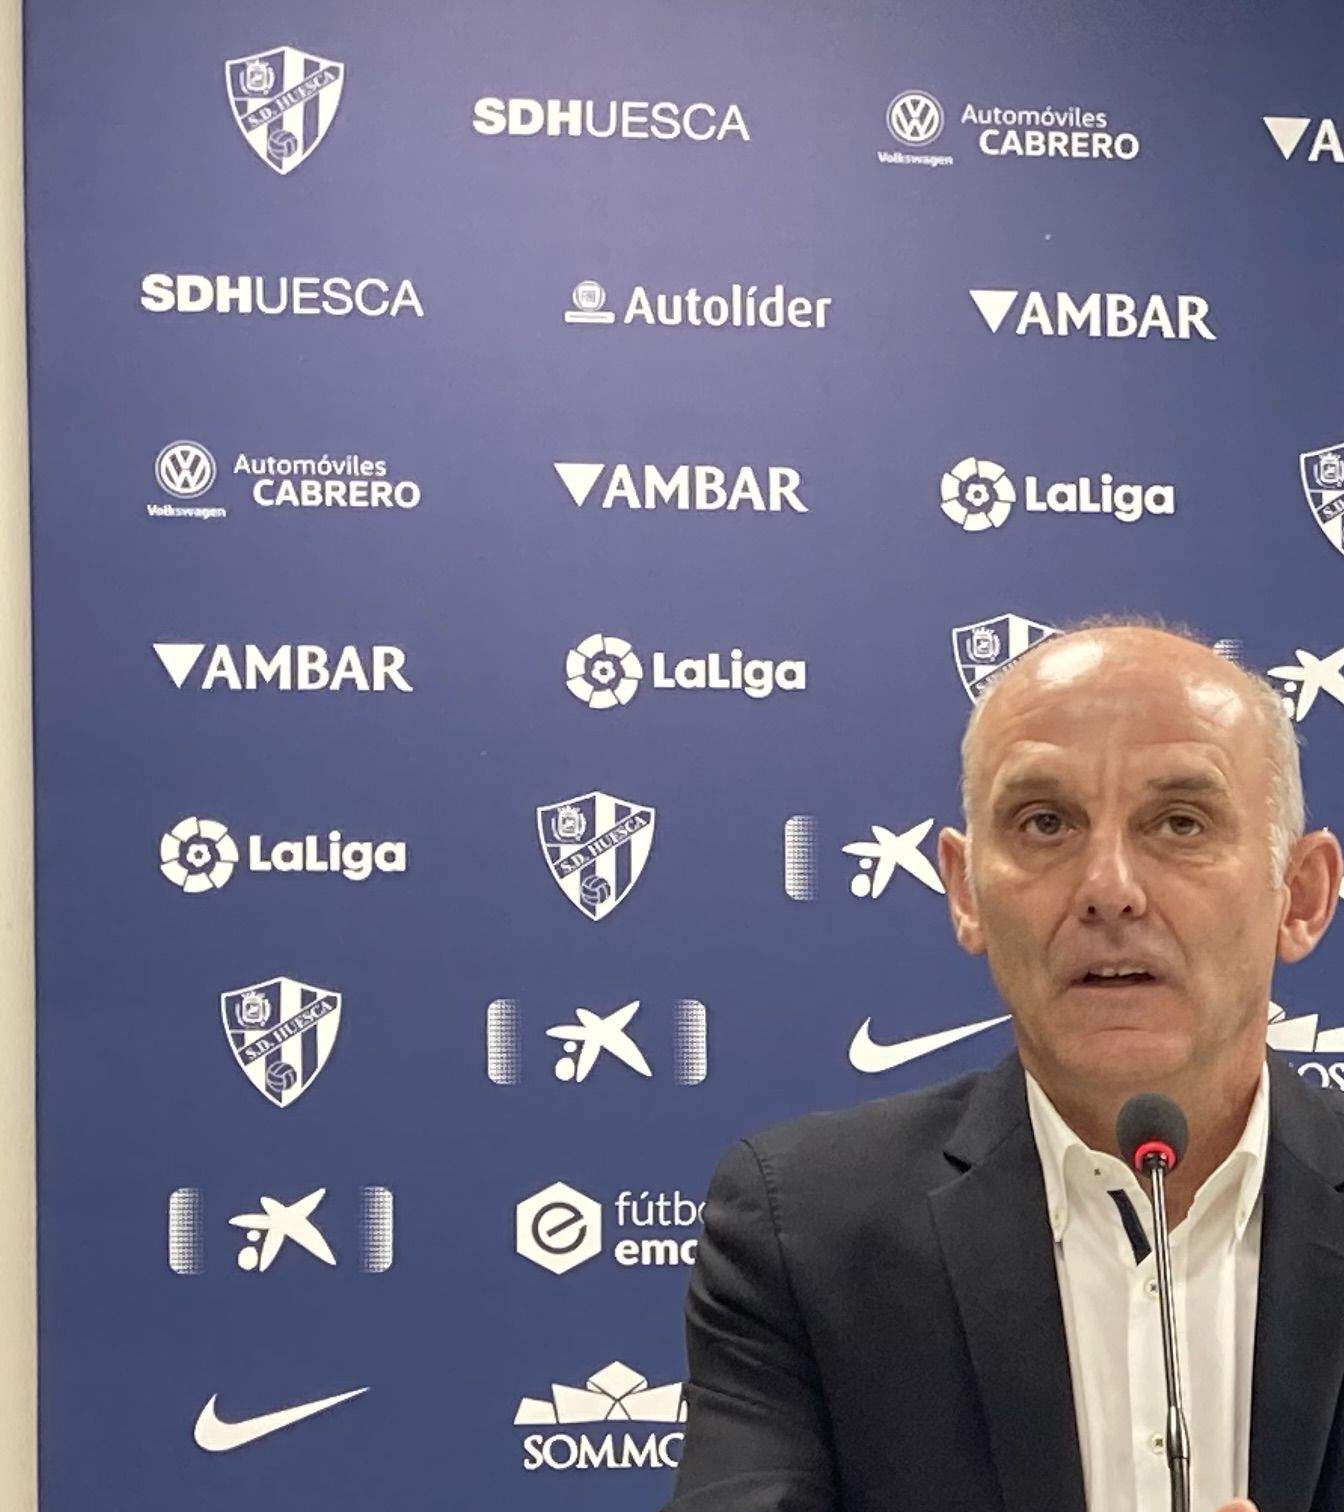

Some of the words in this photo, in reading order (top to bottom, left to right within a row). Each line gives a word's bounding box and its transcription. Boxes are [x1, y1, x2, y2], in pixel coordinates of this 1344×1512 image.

[473, 97, 750, 140] SDHUESCA
[961, 104, 1107, 128] Automóviles
[980, 129, 1139, 159] CABRERO
[141, 274, 424, 317] SDHUESCA
[624, 284, 831, 327] Autolíder
[1016, 292, 1216, 339] AMBAR
[234, 454, 386, 476] Automóviles
[253, 479, 420, 508] CABRERO
[603, 464, 808, 512] AMBAR
[1026, 474, 1174, 522] LaLiga
[202, 645, 413, 691] AMBAR
[654, 649, 805, 698] LaLiga
[250, 831, 406, 880] LaLiga
[615, 1191, 706, 1226] fútb
